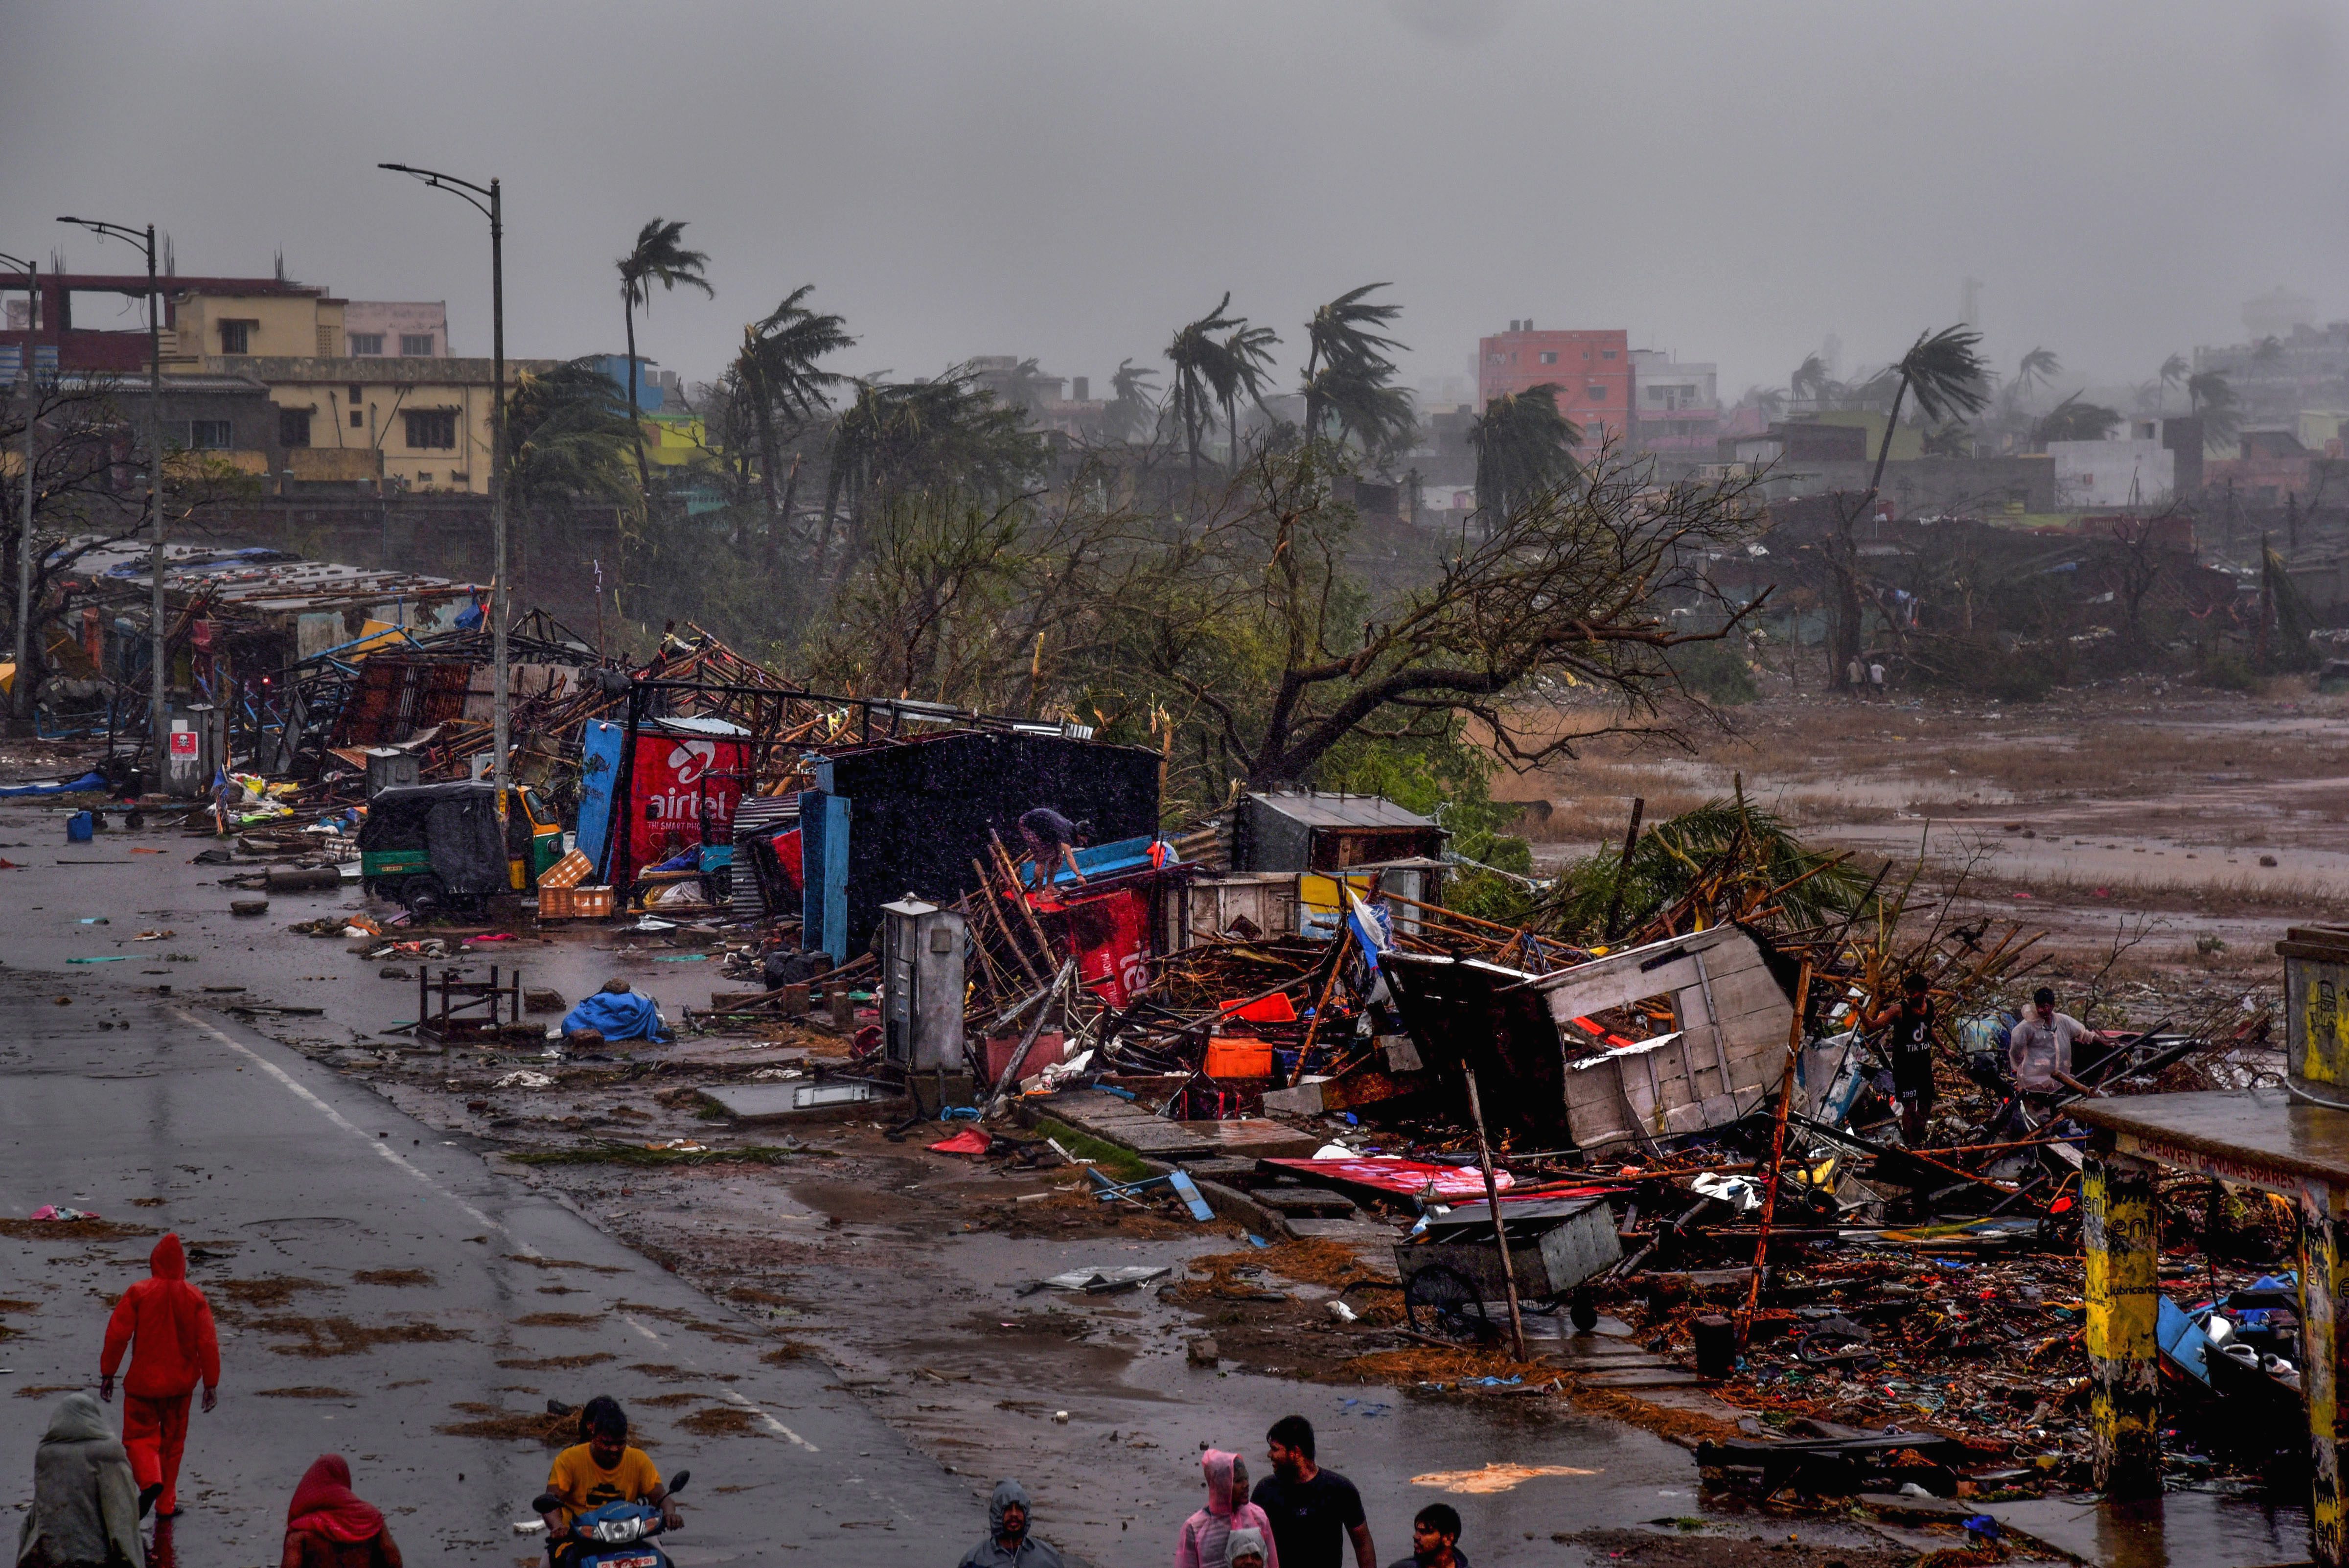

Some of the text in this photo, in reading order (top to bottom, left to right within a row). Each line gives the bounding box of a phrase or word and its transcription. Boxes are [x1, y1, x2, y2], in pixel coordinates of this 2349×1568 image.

[650, 787, 727, 820] airtel
[661, 822, 685, 830] SMART
[1906, 1043, 1918, 1052] Tik
[2139, 1137, 2192, 1164] GREAVES
[2249, 1164, 2296, 1190] SPARES
